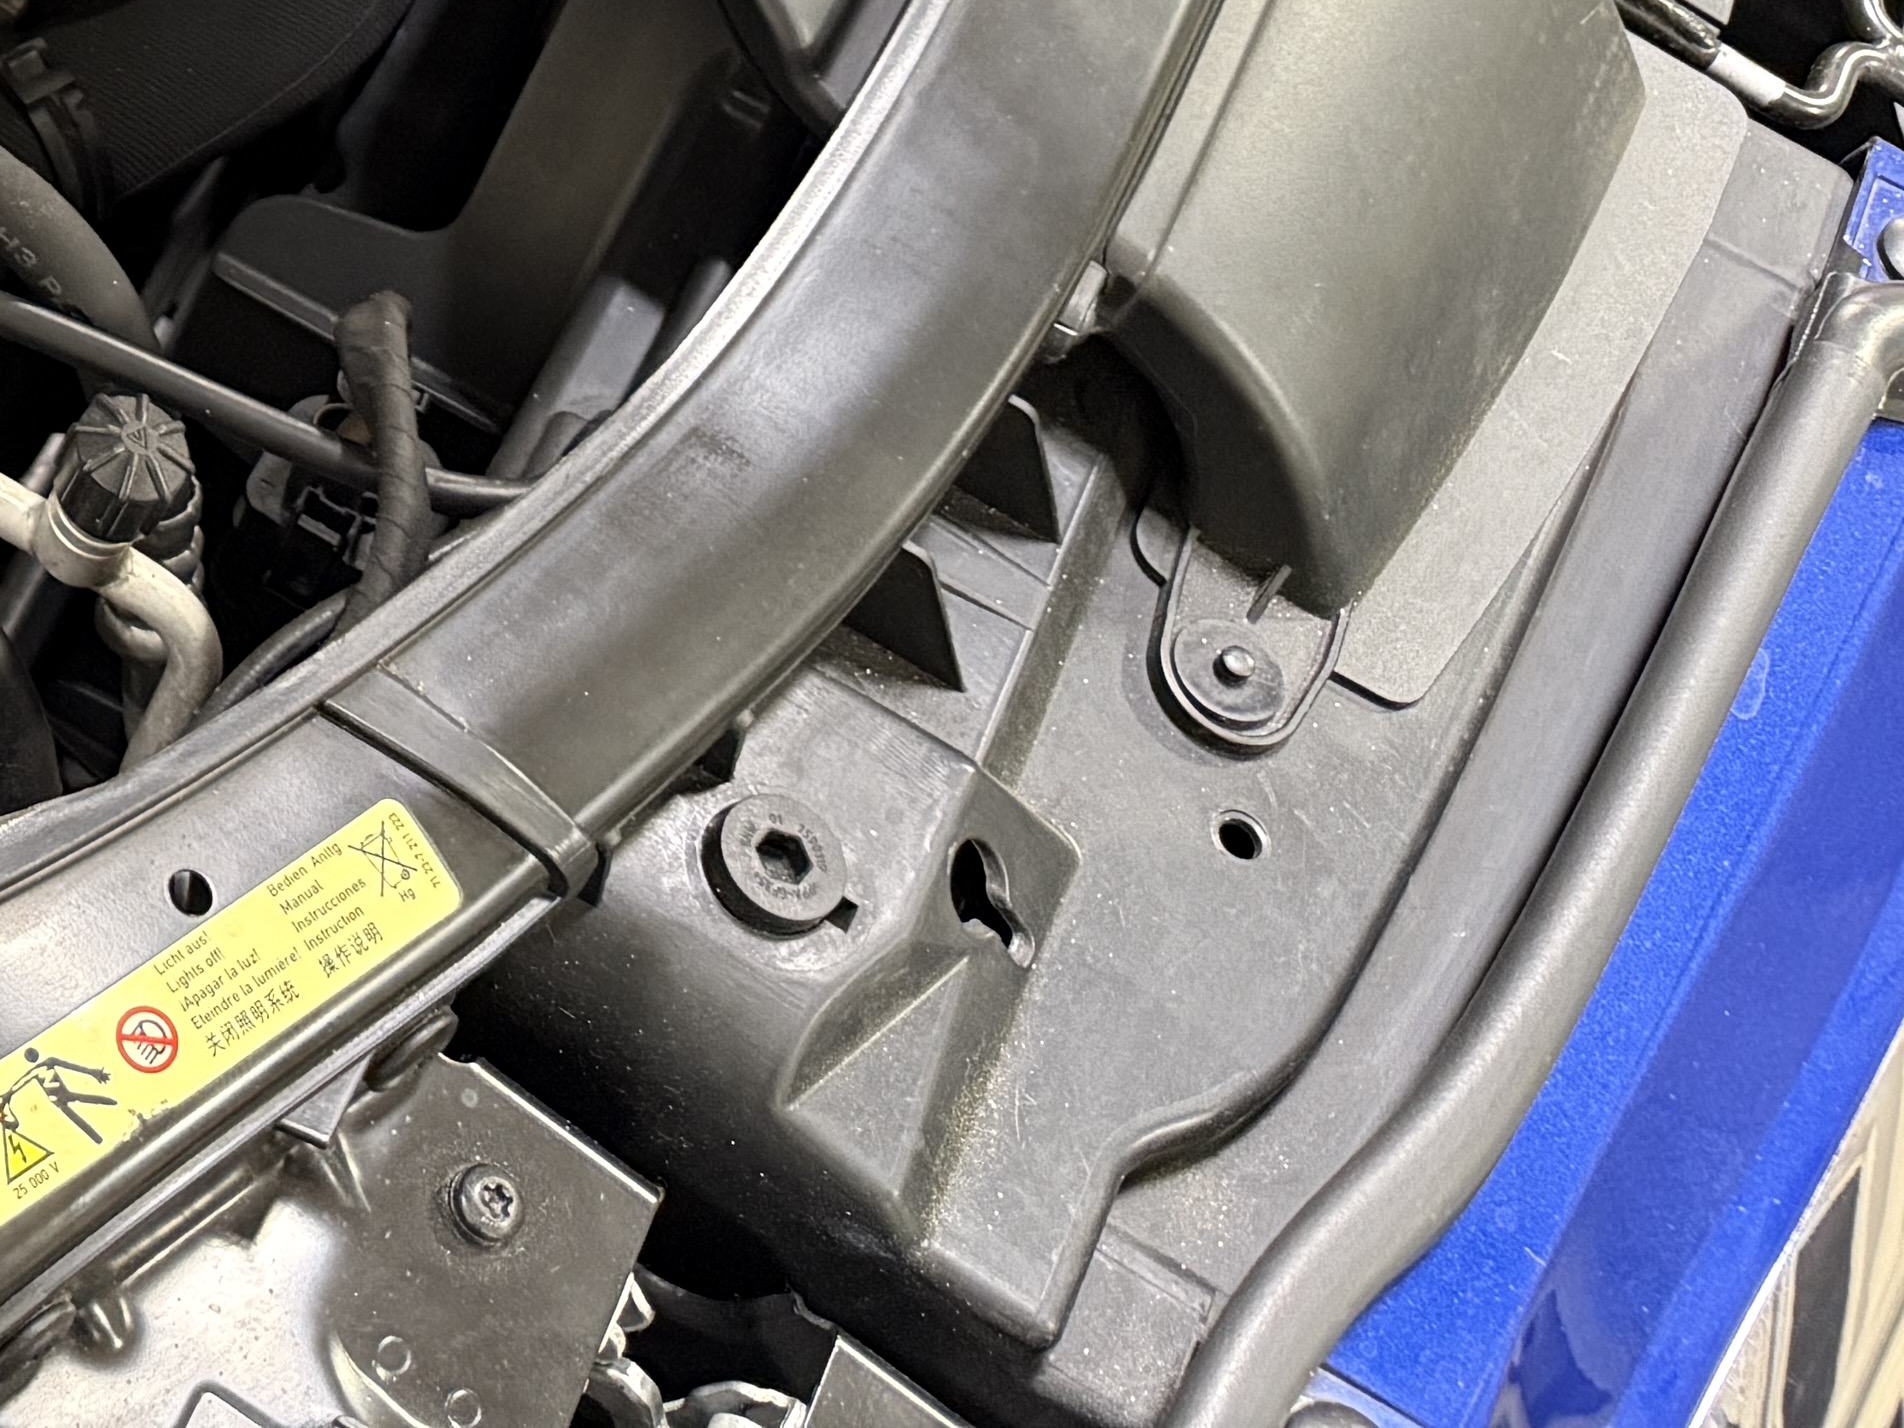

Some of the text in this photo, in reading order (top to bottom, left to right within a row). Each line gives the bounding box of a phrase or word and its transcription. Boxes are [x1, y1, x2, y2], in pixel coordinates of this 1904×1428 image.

[266, 866, 308, 897] Bedien
[279, 879, 324, 915] Manual
[398, 888, 416, 902] Hg
[430, 875, 441, 889] 71
[291, 878, 366, 933] Instrucciones
[303, 906, 365, 951] Instruction
[153, 930, 208, 976] Licht aus!
[223, 967, 239, 980] la
[236, 948, 258, 971] luz!
[318, 921, 383, 979] 操作说明
[166, 947, 222, 993] Lights off!
[239, 983, 254, 996] la
[205, 980, 300, 1057] 关闭照明系统
[13, 1161, 59, 1200] 25 000 V
